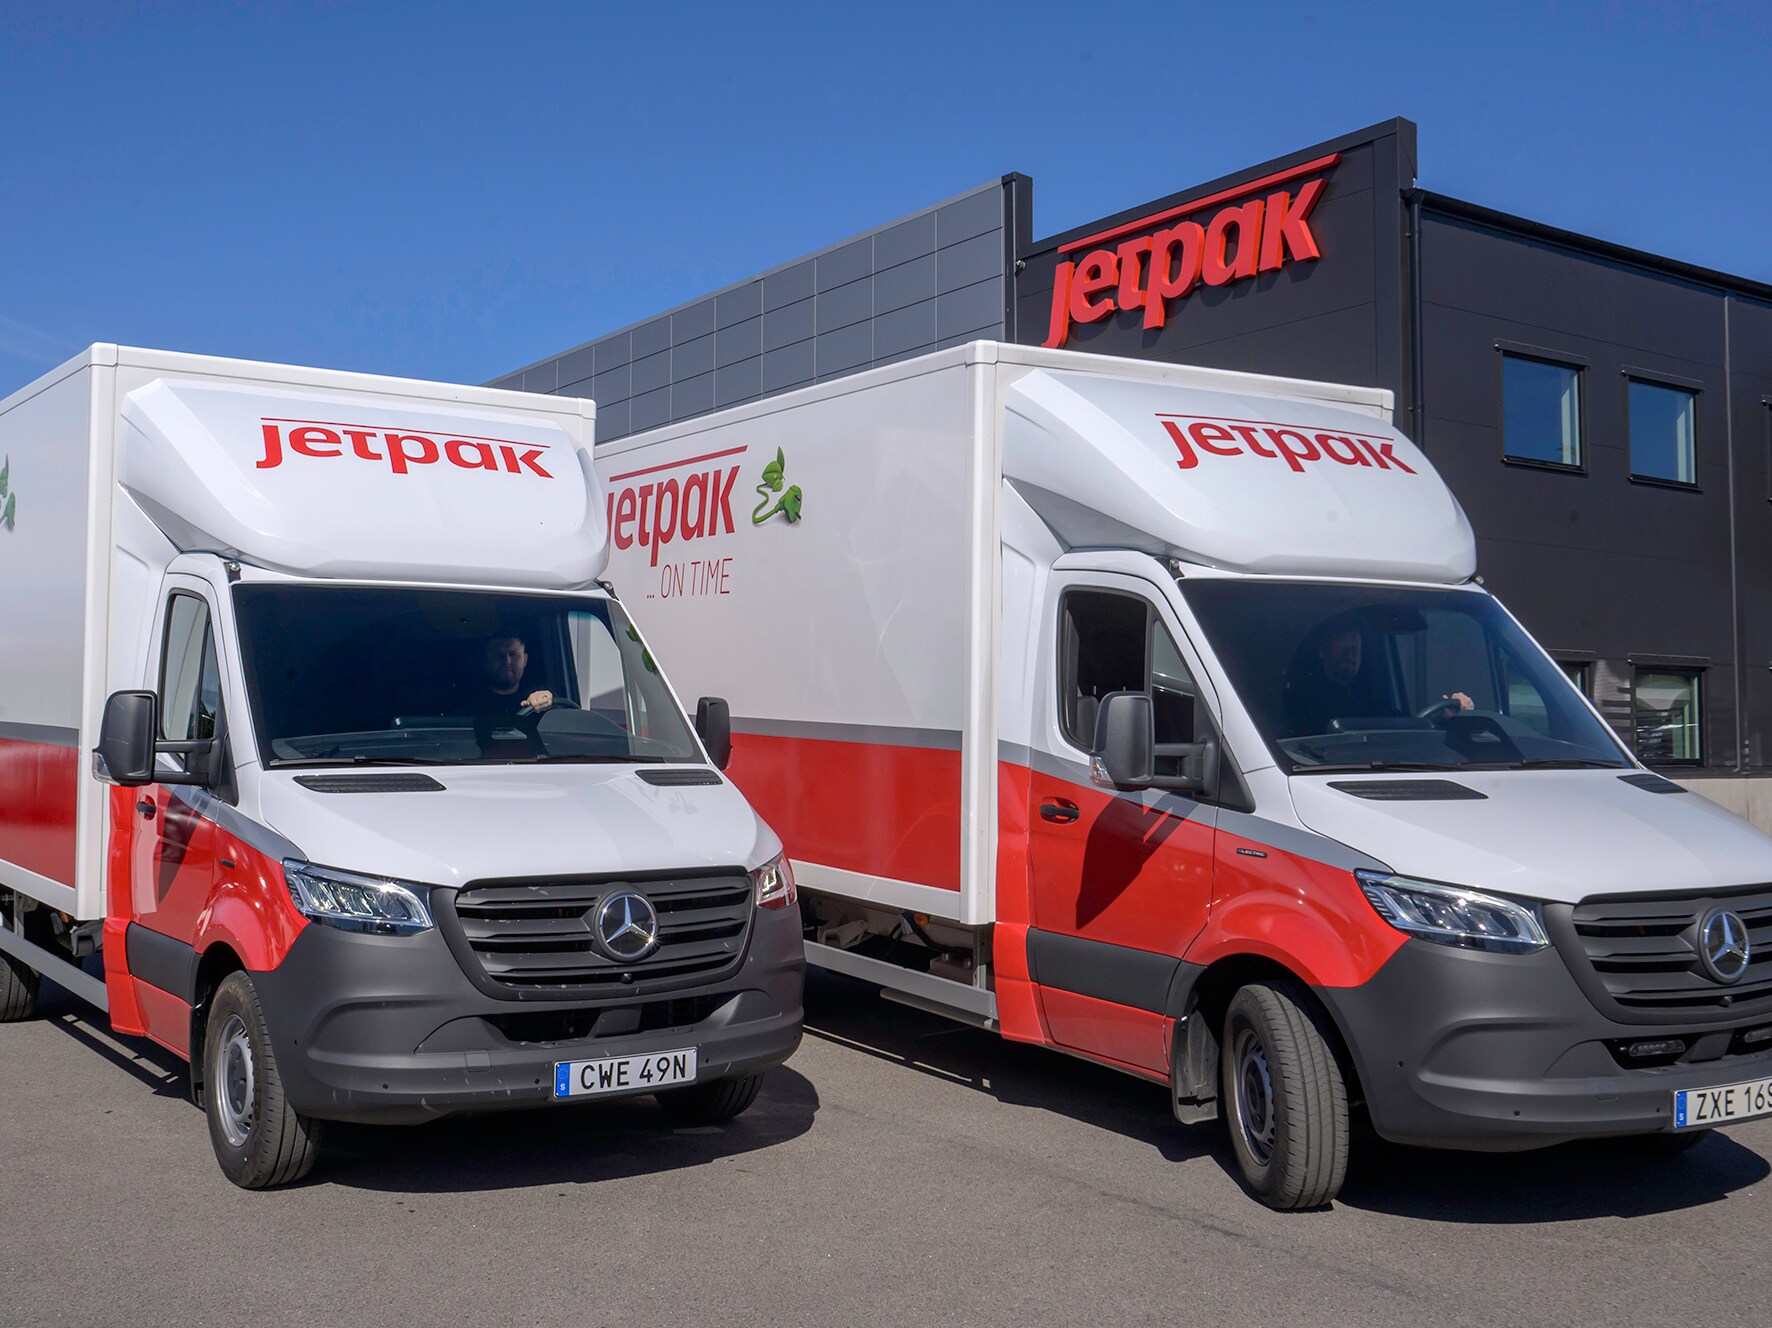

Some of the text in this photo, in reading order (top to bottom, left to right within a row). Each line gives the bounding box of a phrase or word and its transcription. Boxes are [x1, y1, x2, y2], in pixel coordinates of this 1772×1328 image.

[1041, 179, 1328, 348] jetpak
[660, 563, 686, 599] ON
[690, 558, 733, 596] TIME
[580, 1054, 687, 1090] CWE 49N
[1679, 1113, 1685, 1121] S
[1696, 1089, 1735, 1121] ZXE
